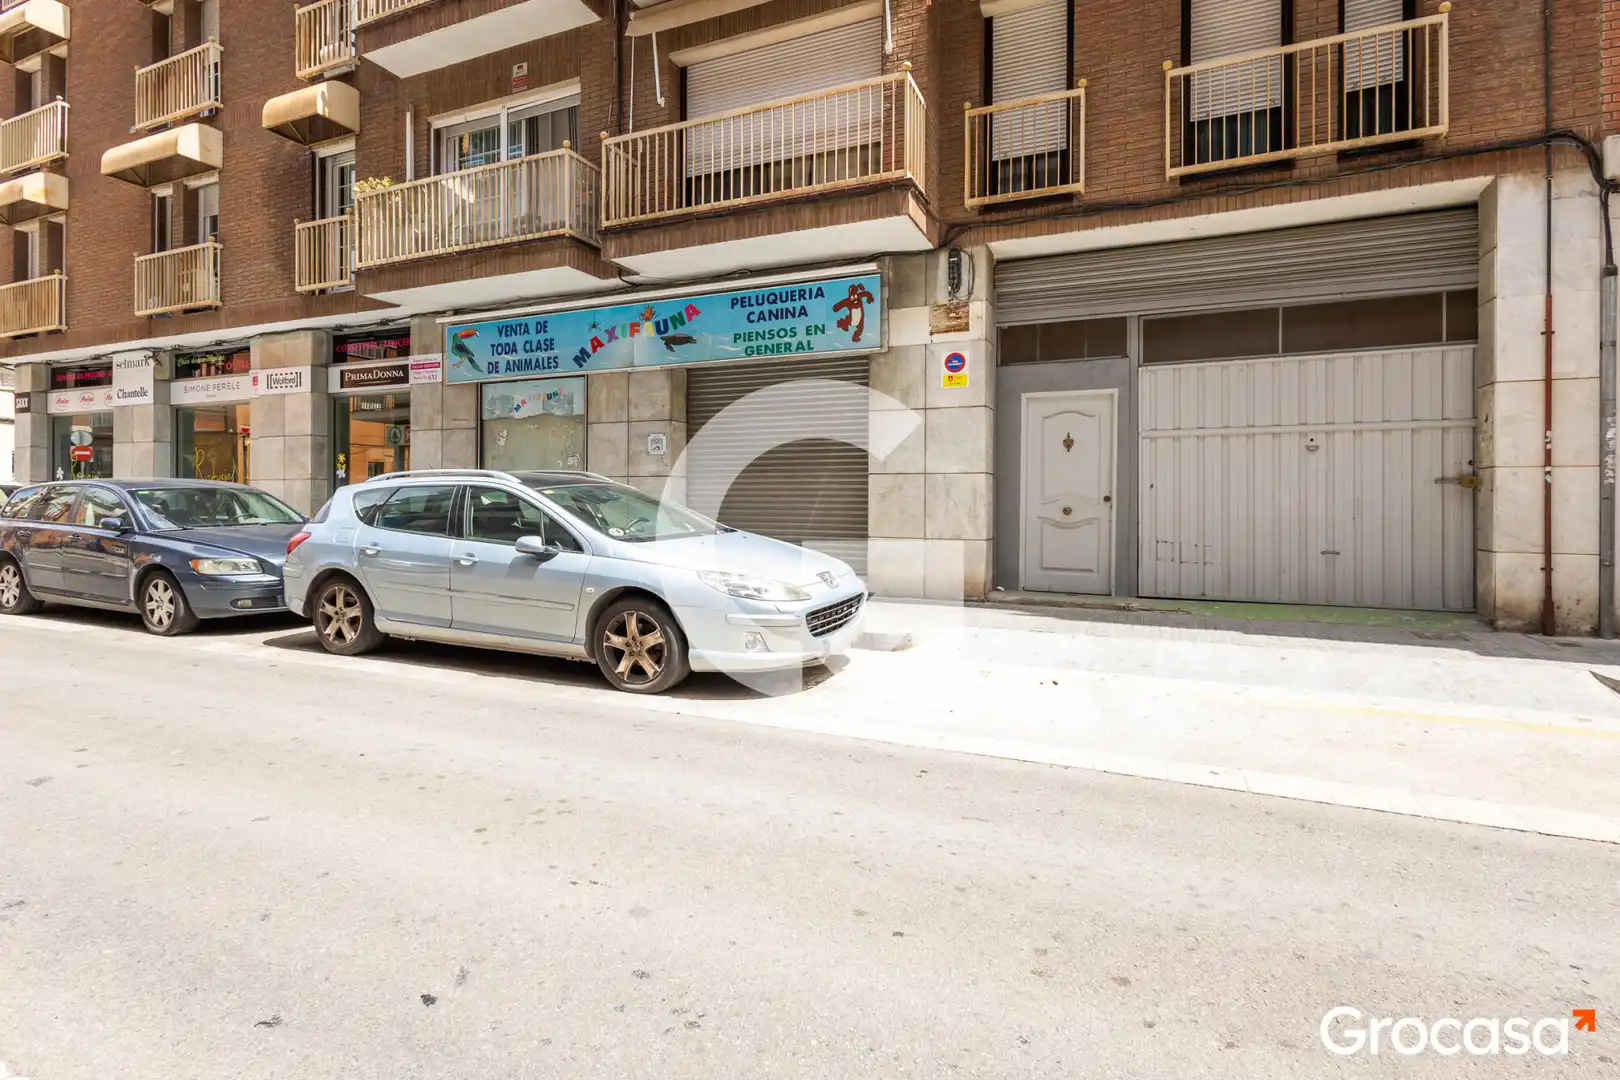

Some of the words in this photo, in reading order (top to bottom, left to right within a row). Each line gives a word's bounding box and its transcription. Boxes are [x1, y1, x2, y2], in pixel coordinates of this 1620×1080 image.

[730, 286, 825, 309] PELUQUERIA
[746, 305, 809, 324] CANINA
[497, 322, 530, 338] VENTA
[536, 320, 548, 334] DE
[572, 303, 702, 369] MAXIFAUNA
[733, 327, 798, 344] PIENSOS
[806, 324, 826, 336] EN
[490, 341, 518, 356] TODA
[523, 338, 555, 354] CLASE
[744, 340, 815, 356] GENERAL
[487, 361, 500, 375] DE
[505, 356, 559, 373] ANIMALES
[116, 386, 149, 399] Chantelle
